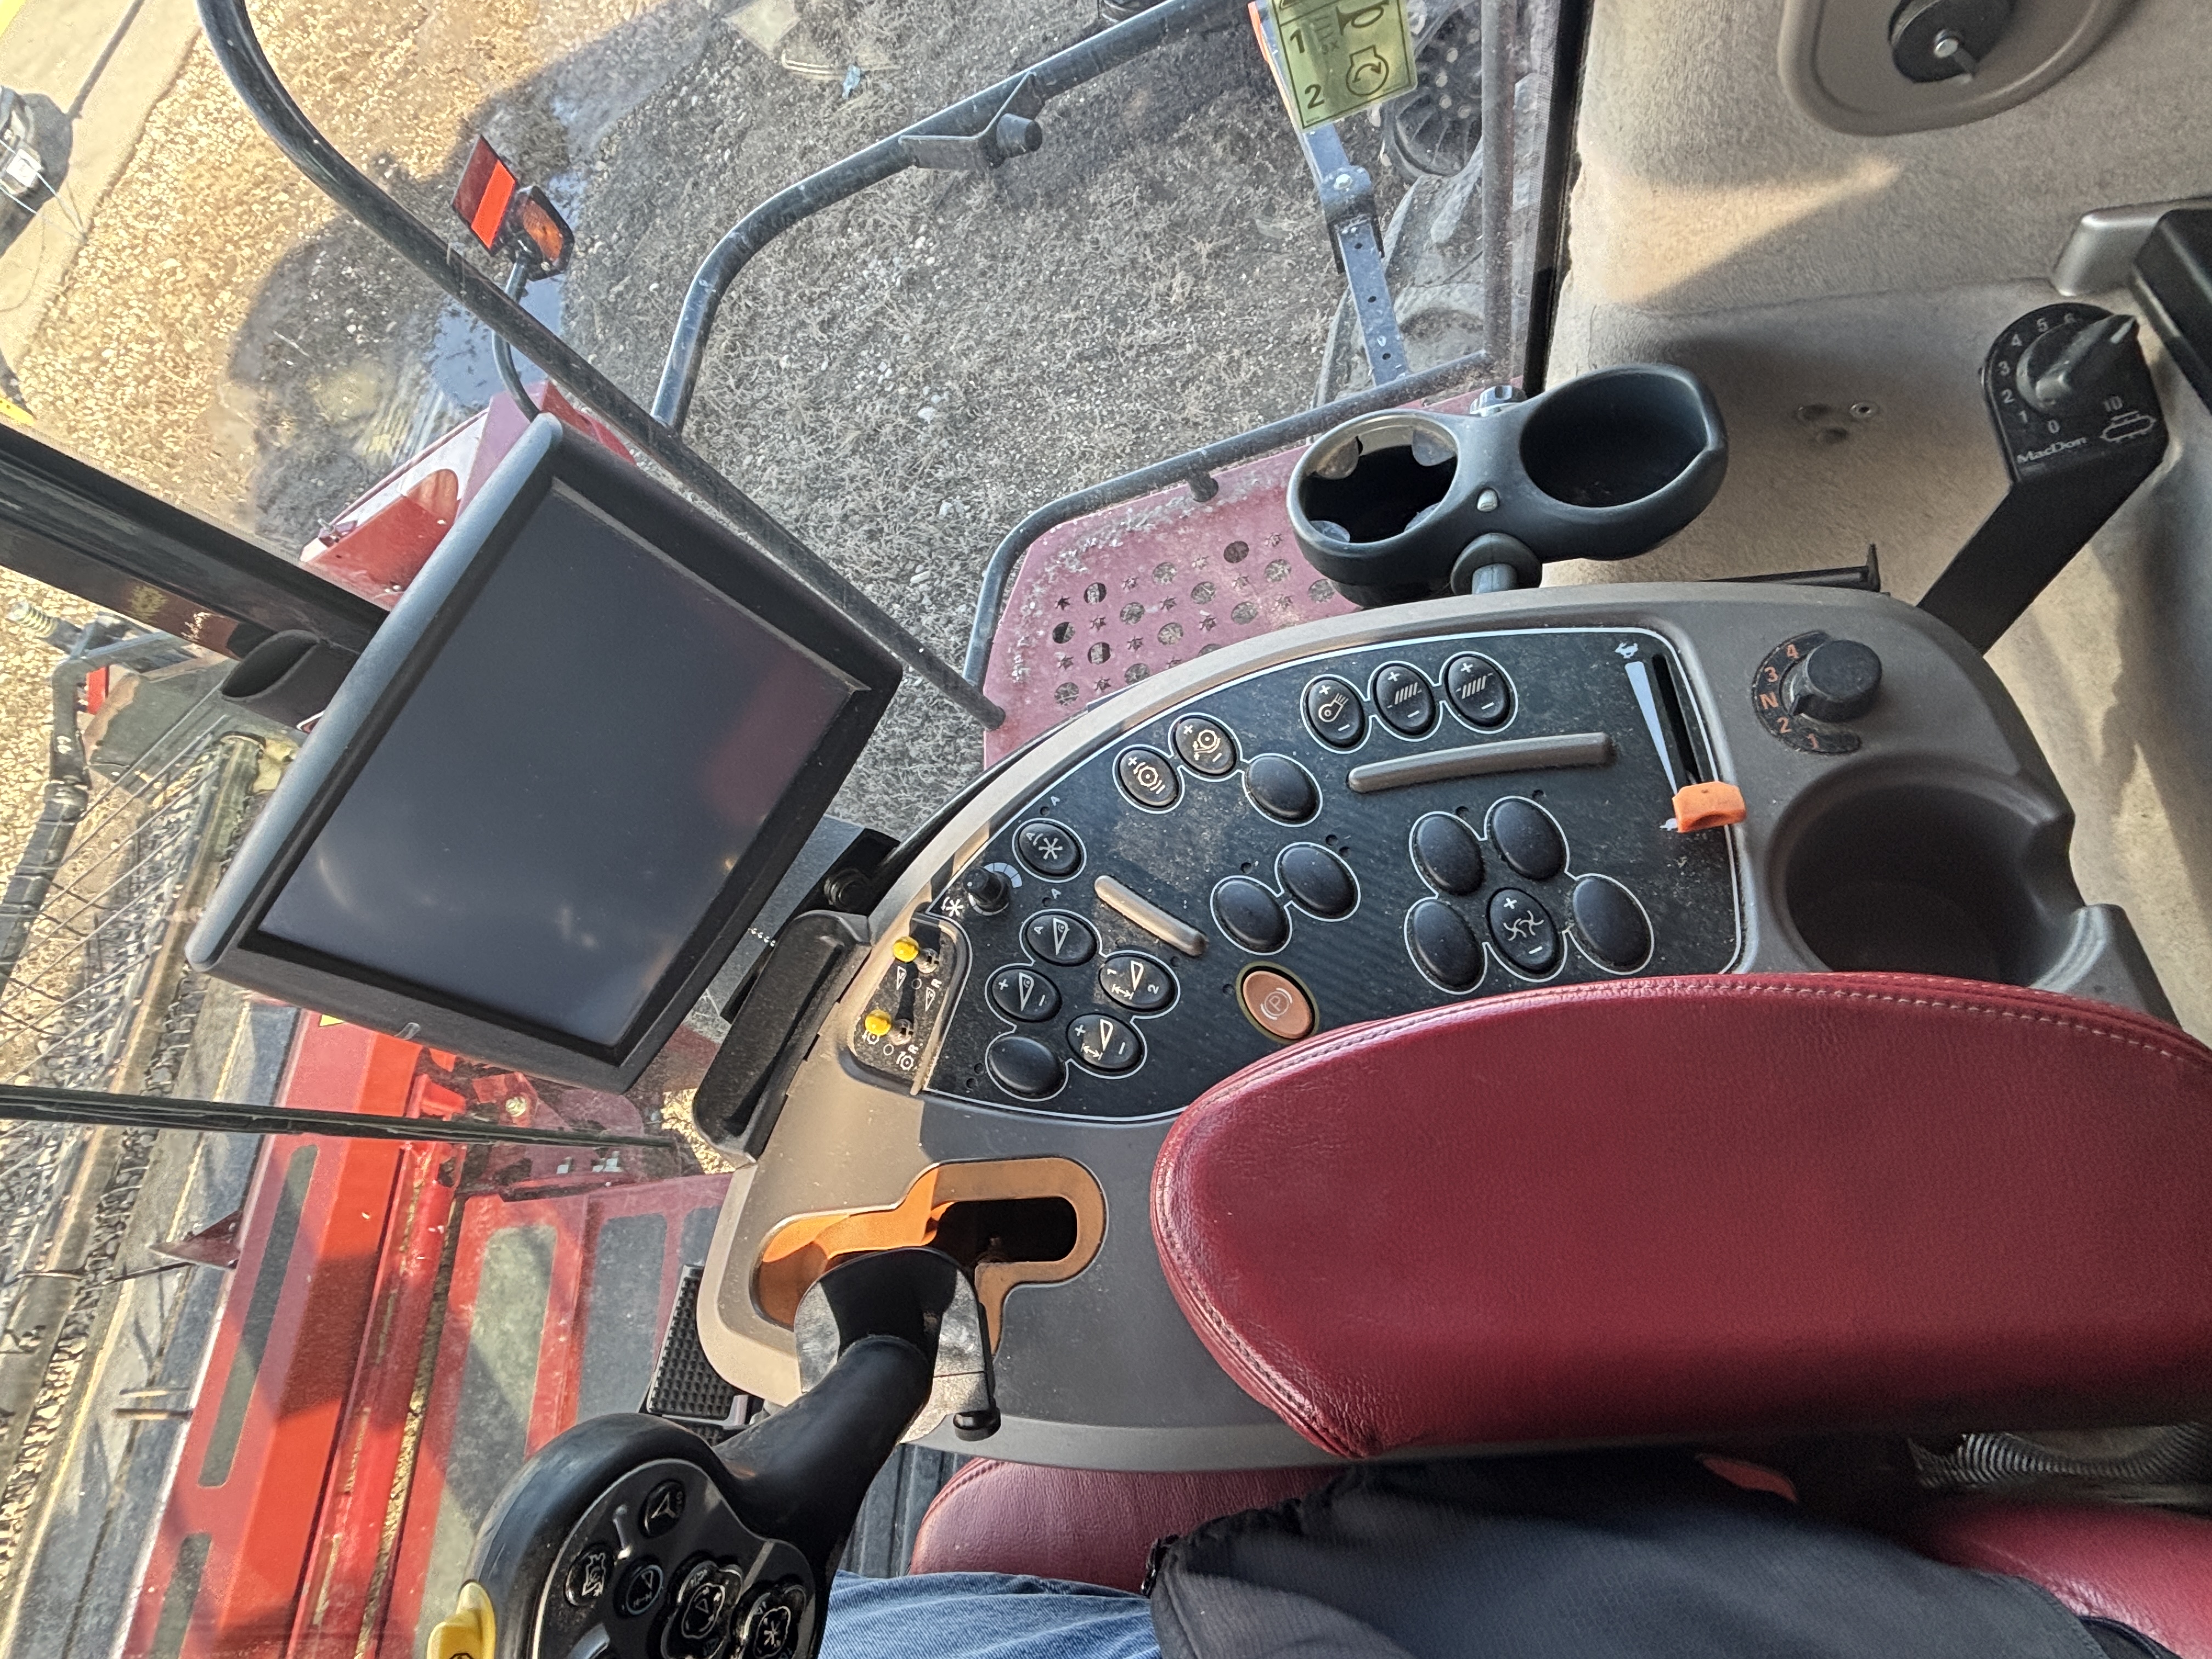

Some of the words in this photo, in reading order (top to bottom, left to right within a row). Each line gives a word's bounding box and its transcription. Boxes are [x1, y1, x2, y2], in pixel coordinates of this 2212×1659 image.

[1289, 29, 1305, 54] 1
[1305, 84, 1324, 109] 2
[2011, 334, 2023, 347] 4
[1999, 360, 2010, 376] 3
[2002, 388, 2014, 404] 2
[2019, 410, 2028, 424] 1
[2017, 437, 2087, 464] MacDon
[1786, 644, 1799, 658] 4
[1764, 667, 1779, 682] 3
[1759, 692, 1779, 710] N
[1776, 716, 1792, 733] 2
